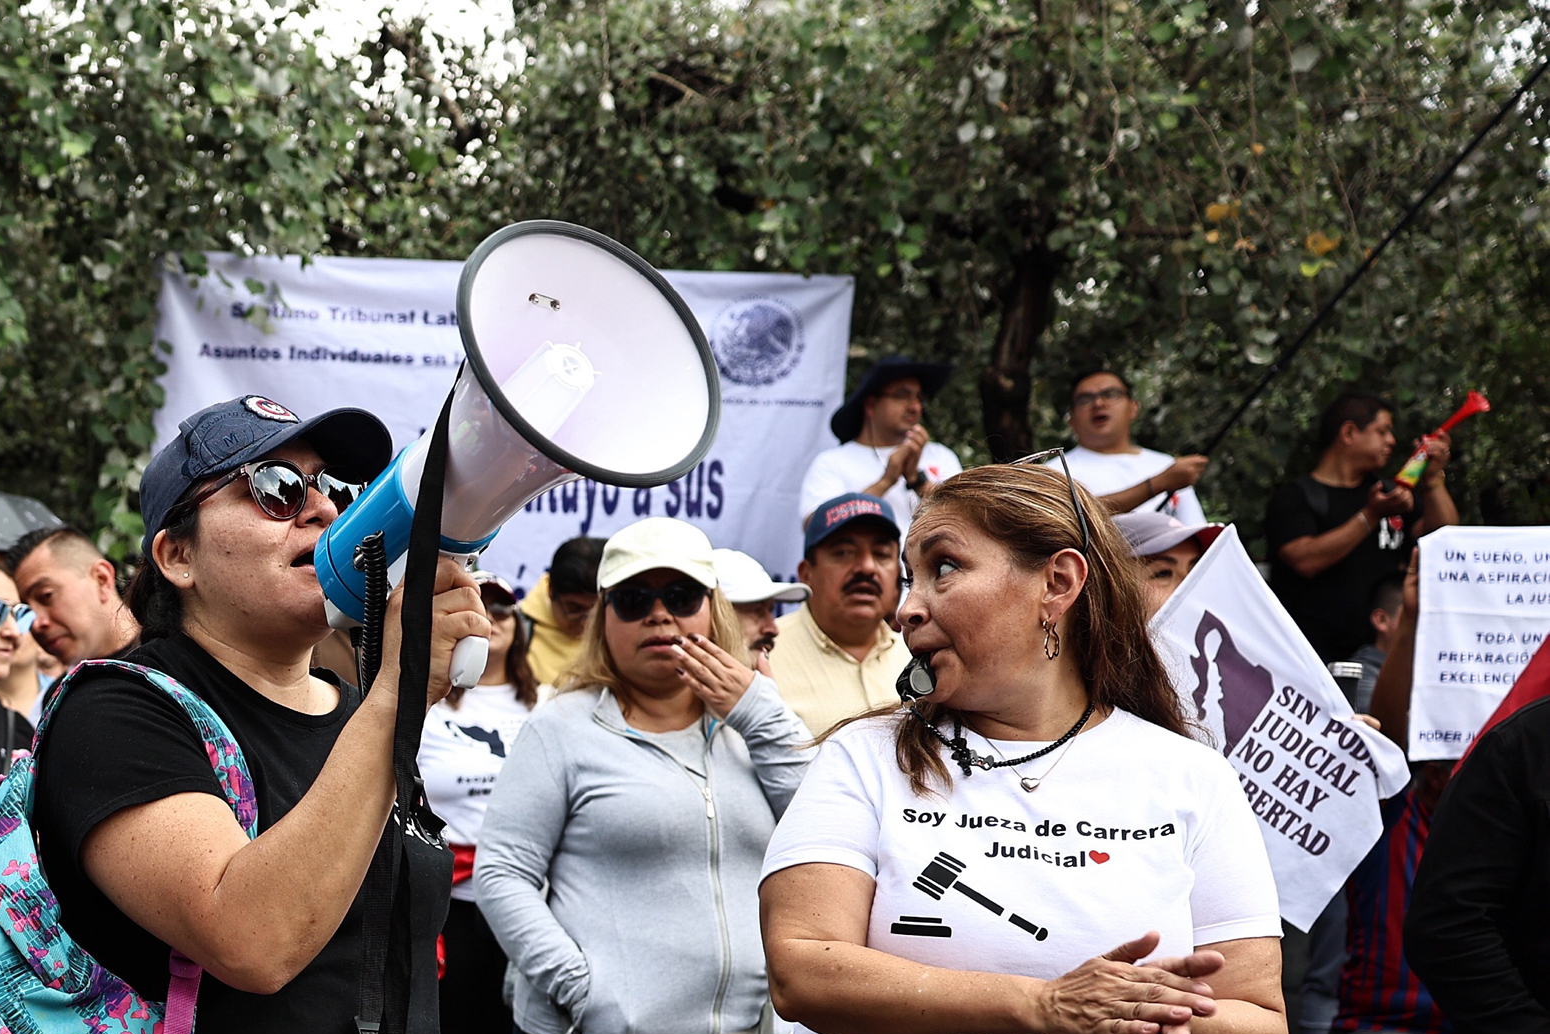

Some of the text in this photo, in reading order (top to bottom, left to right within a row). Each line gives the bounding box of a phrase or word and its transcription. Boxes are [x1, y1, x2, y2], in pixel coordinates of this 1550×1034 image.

[231, 302, 319, 320] Stimo
[329, 307, 416, 324] Tribunal
[199, 343, 281, 360] Asuntos
[289, 345, 414, 364] Individuales
[665, 459, 724, 519] sus
[1445, 550, 1466, 562] UN
[1438, 570, 1550, 585] UNA ASPIRACI
[1506, 592, 1550, 605] LA JU
[1476, 632, 1516, 645] TODA
[1438, 649, 1535, 665] PREPARACIÓ
[1276, 685, 1380, 779] SIN POD
[1419, 730, 1462, 743] PODER
[1252, 708, 1361, 798] JUDICIAL
[1236, 736, 1330, 813] NO HAY
[902, 807, 1176, 841] Soy Jueza de Carrera
[1238, 772, 1331, 857] BERTAD
[984, 841, 1087, 868] Judicial
